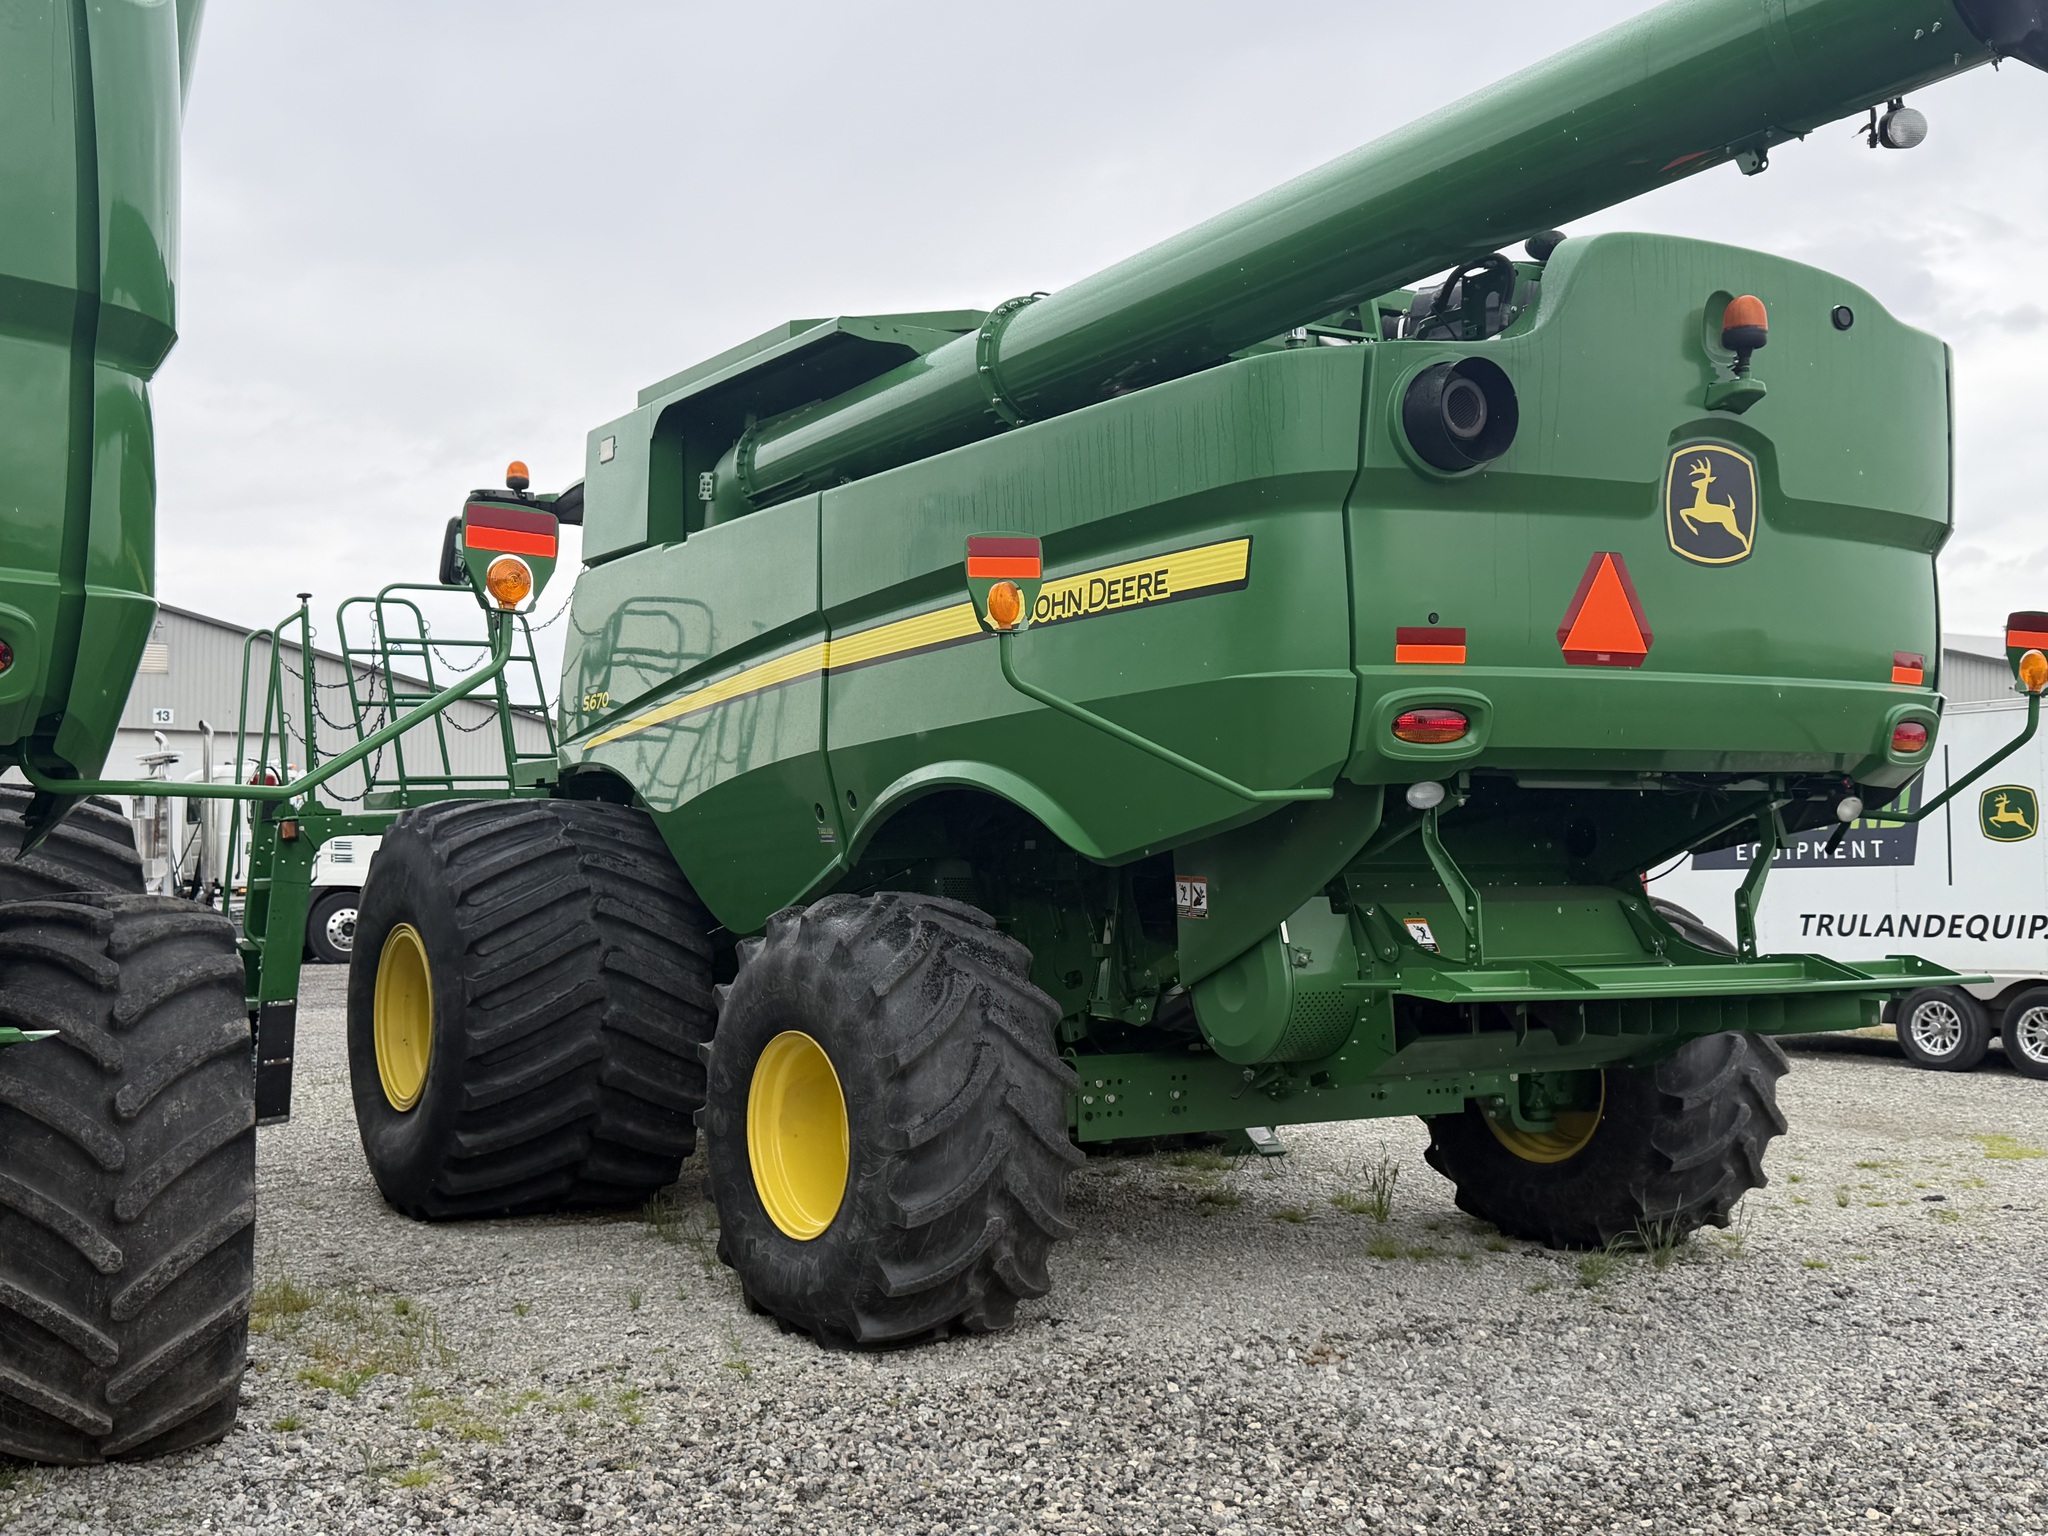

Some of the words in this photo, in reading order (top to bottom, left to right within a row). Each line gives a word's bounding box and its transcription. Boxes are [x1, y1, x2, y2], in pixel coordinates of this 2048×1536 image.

[1089, 568, 1169, 608] DEERE
[582, 691, 610, 712] S670
[156, 710, 170, 721] 13
